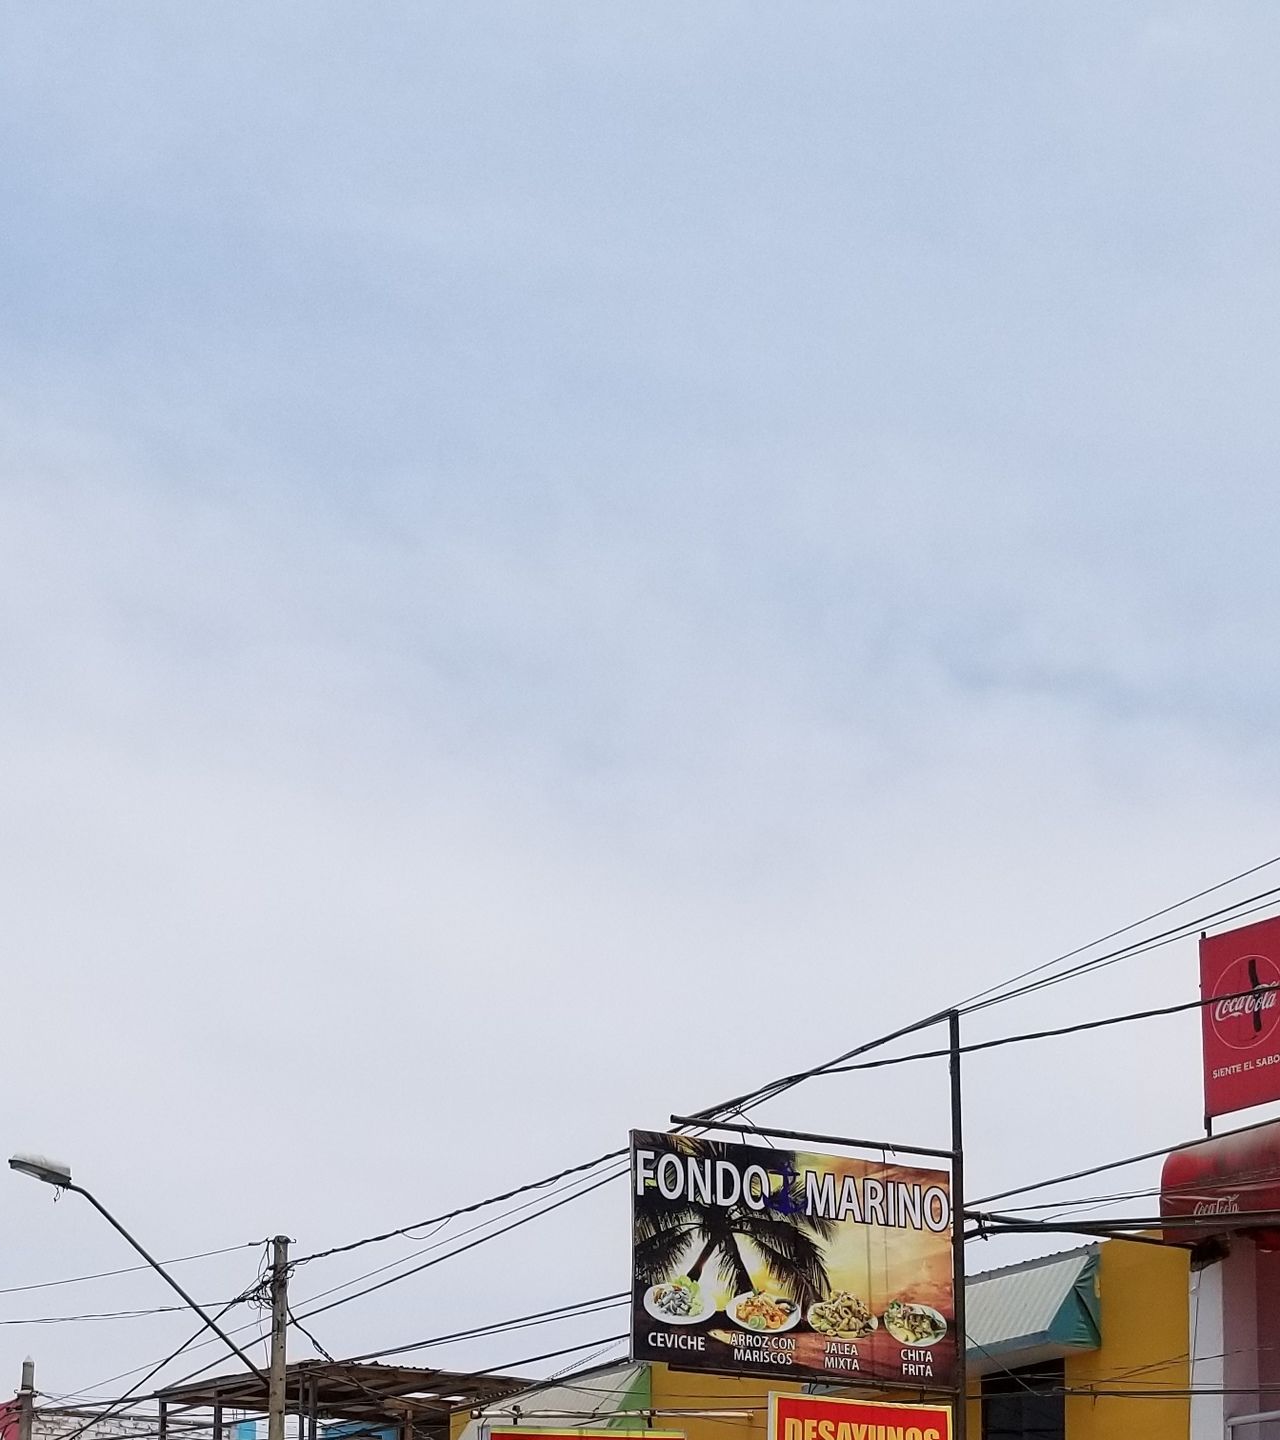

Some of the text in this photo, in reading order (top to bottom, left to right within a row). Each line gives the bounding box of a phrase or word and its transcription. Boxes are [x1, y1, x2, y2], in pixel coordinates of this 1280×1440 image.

[1212, 1063, 1242, 1079] SIENTE
[1243, 1061, 1254, 1071] EL
[636, 1149, 950, 1233] FONDO MARINO
[647, 1331, 706, 1351] CEVICHE
[729, 1333, 796, 1351] ARROZ CON
[825, 1341, 858, 1356] JALEA
[733, 1347, 793, 1365] MARISCOS
[824, 1356, 860, 1371] MIXTA
[900, 1348, 933, 1363] CHITA
[902, 1363, 933, 1378] FRITA
